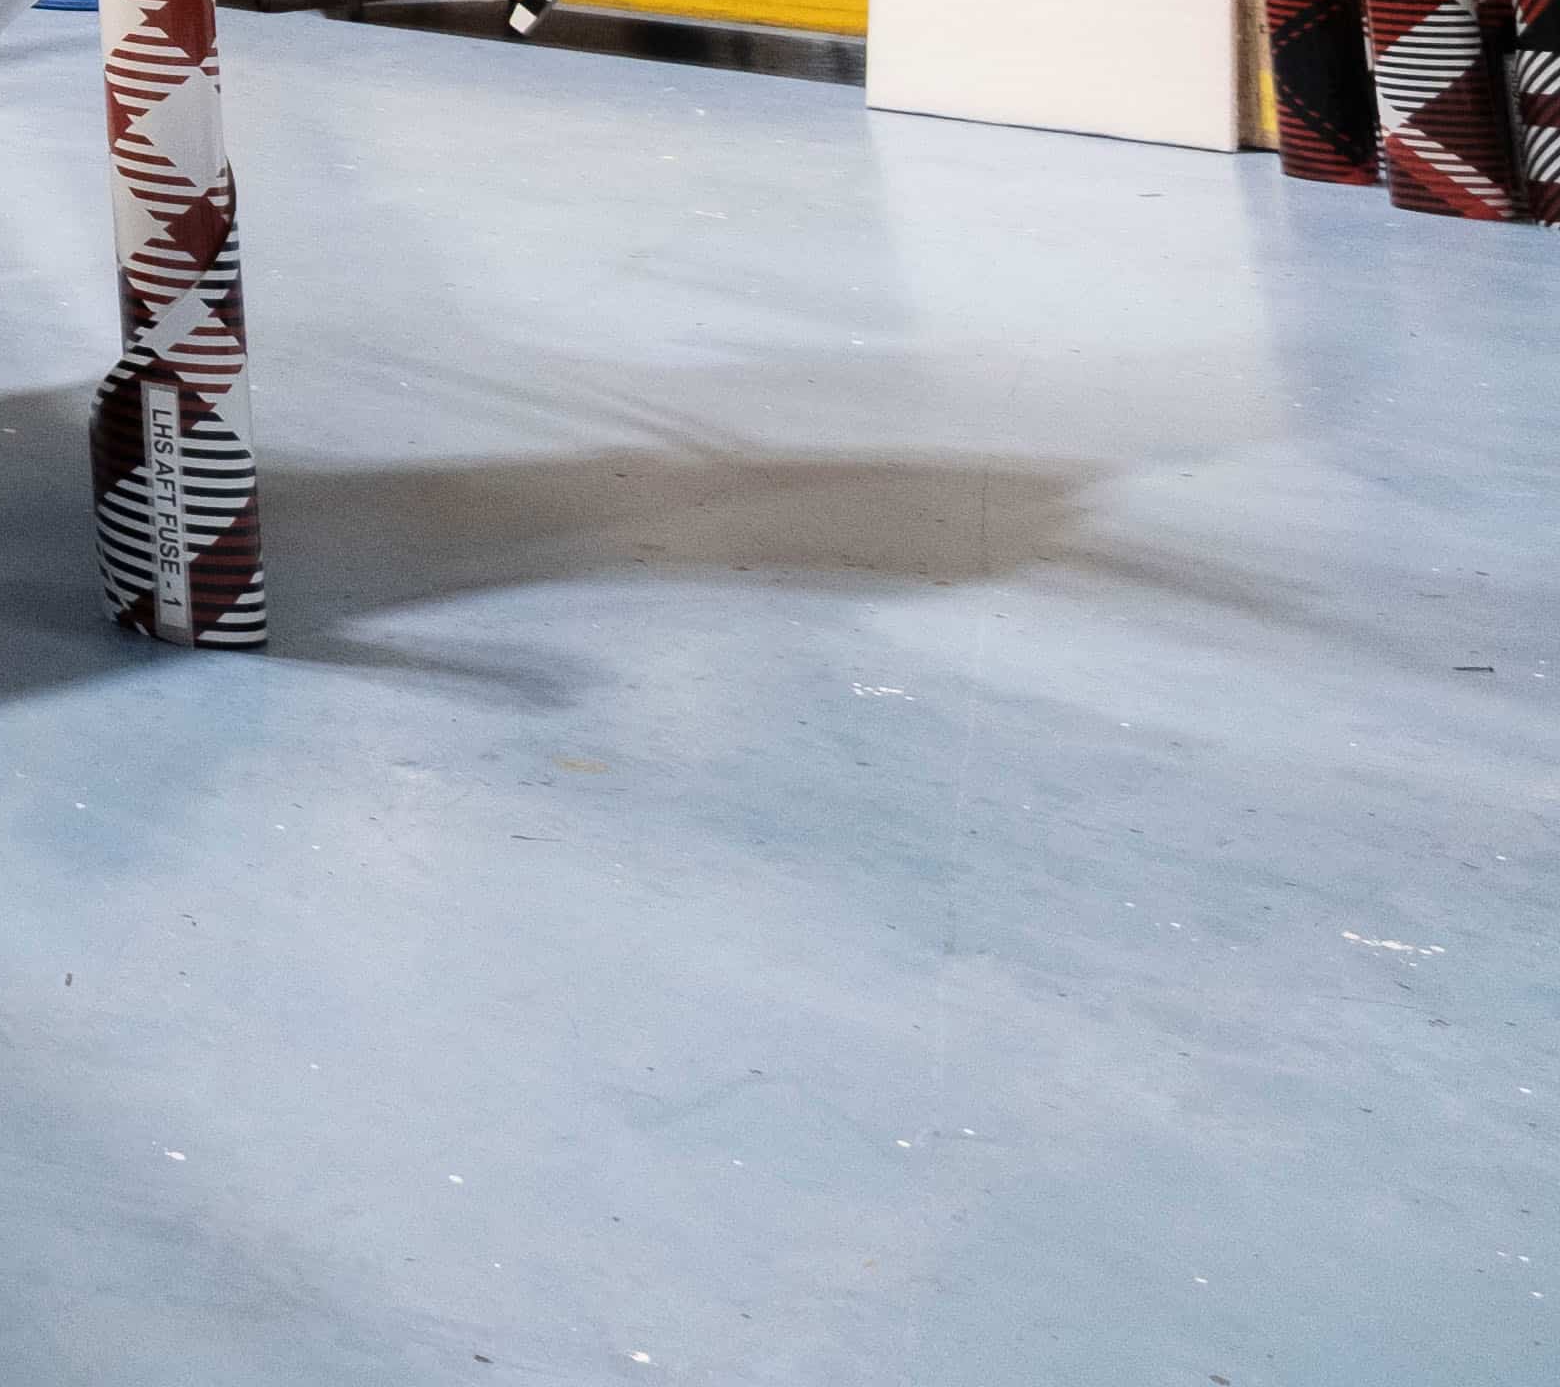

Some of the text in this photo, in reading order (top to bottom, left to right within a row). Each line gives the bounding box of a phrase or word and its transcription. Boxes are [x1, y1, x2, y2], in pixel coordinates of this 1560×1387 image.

[151, 408, 174, 454] LHS
[155, 459, 177, 507] AFT
[157, 511, 181, 575] FUSE
[162, 597, 182, 608] 1
